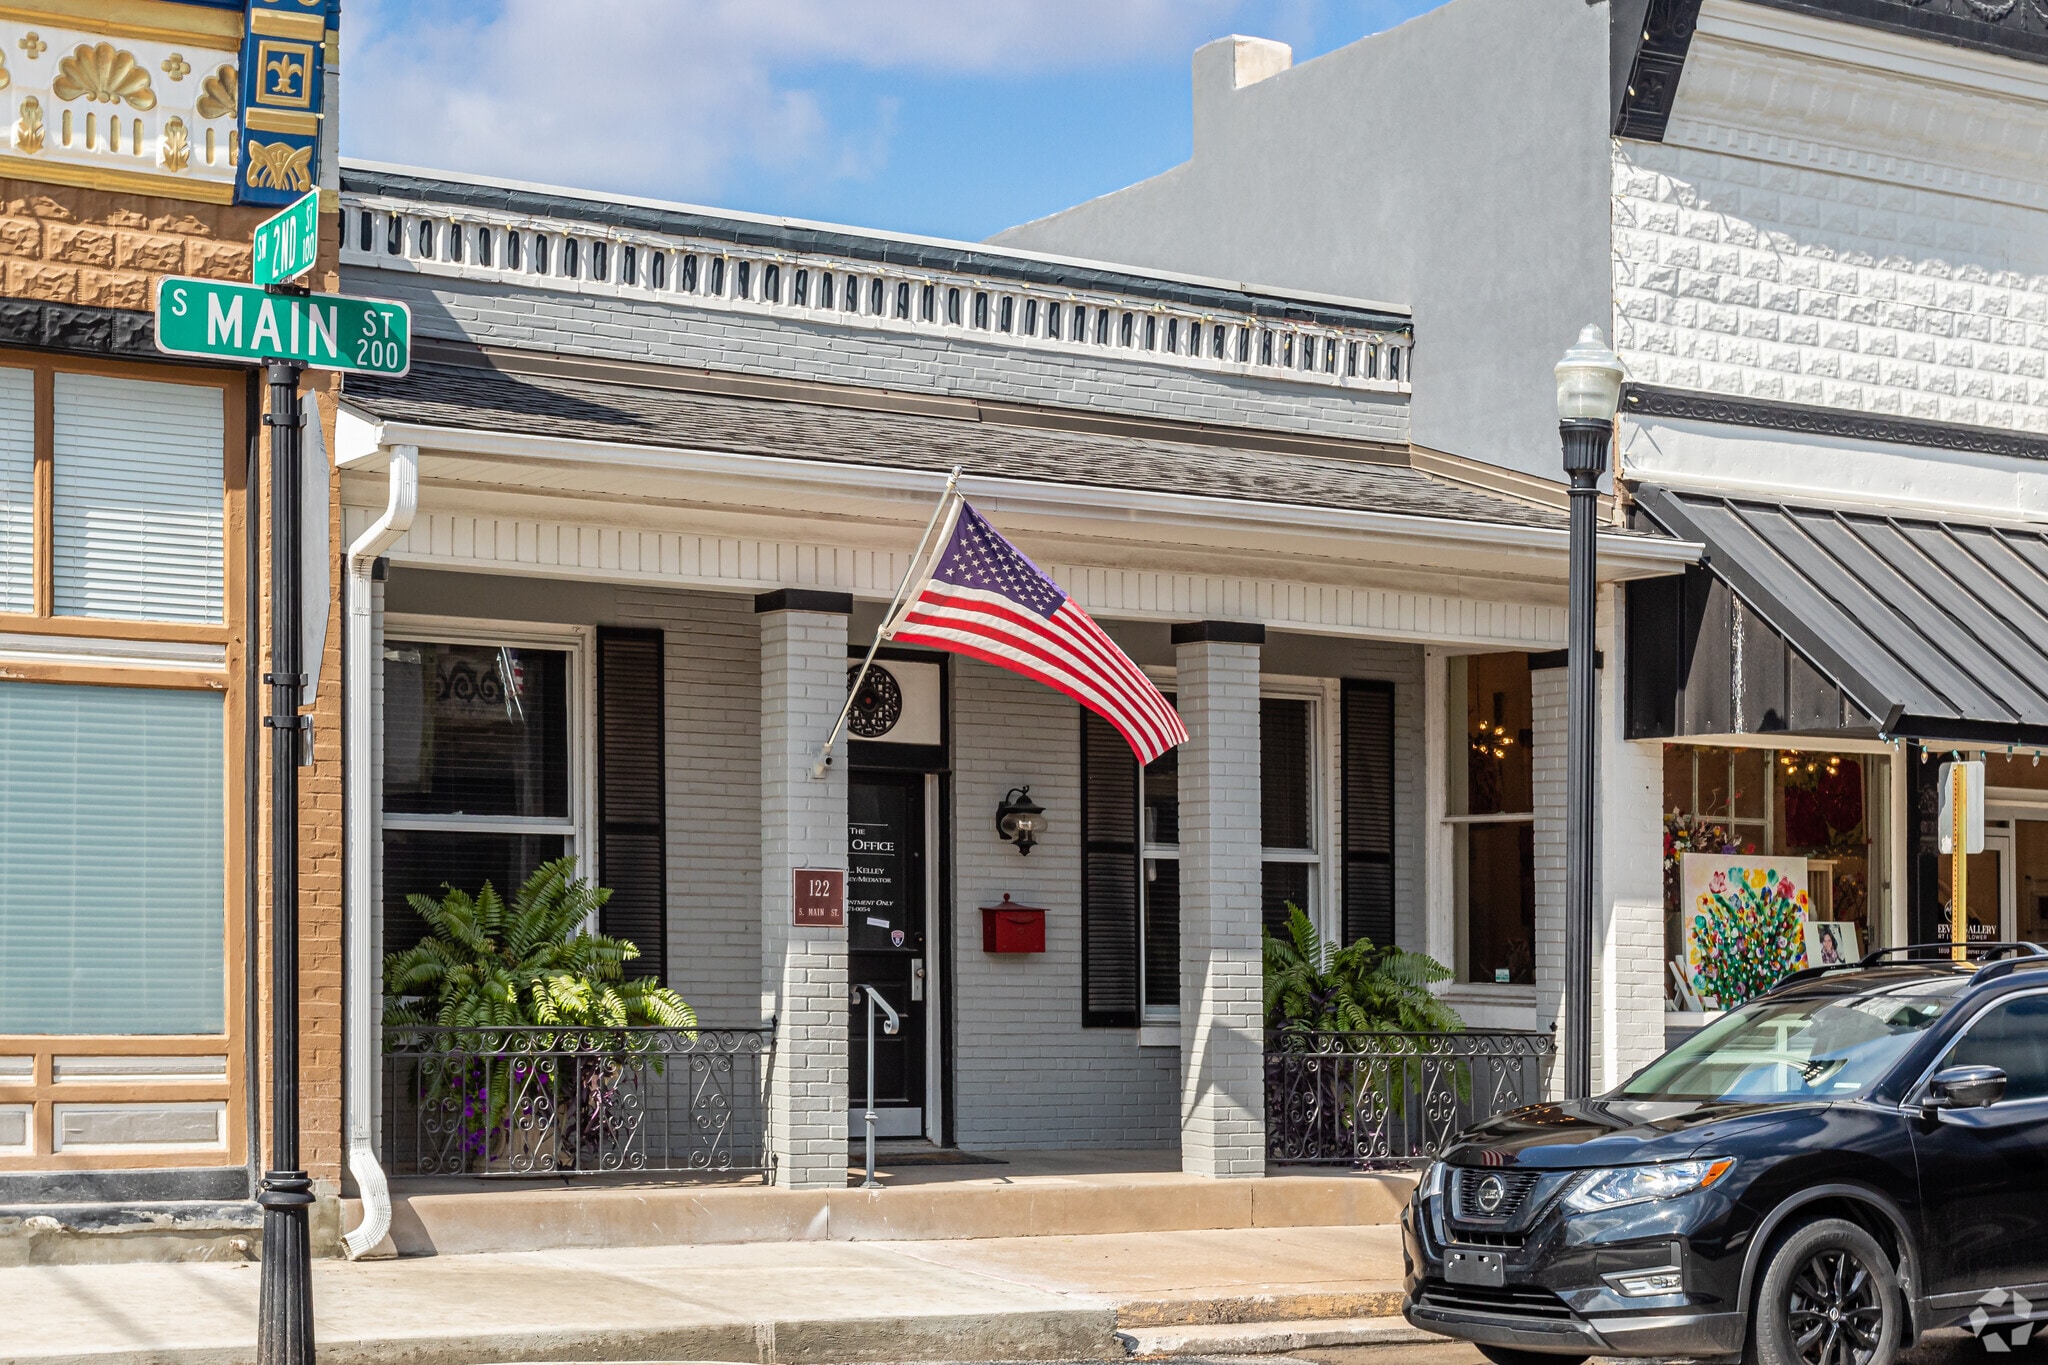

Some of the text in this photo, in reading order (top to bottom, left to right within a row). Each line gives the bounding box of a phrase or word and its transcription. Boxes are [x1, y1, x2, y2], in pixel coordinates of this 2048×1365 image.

[257, 202, 314, 279] SW 2ND ST
[302, 232, 315, 265] 100
[171, 288, 394, 359] S MAIN ST
[356, 338, 399, 369] 200
[849, 827, 866, 836] THE
[852, 839, 894, 851] OFFICE
[856, 866, 885, 875] KELLEY
[848, 876, 892, 884] EY/MEDIATOR
[809, 880, 830, 896] 122
[808, 908, 825, 917] MAIN
[1966, 925, 1996, 934] ALLERY
